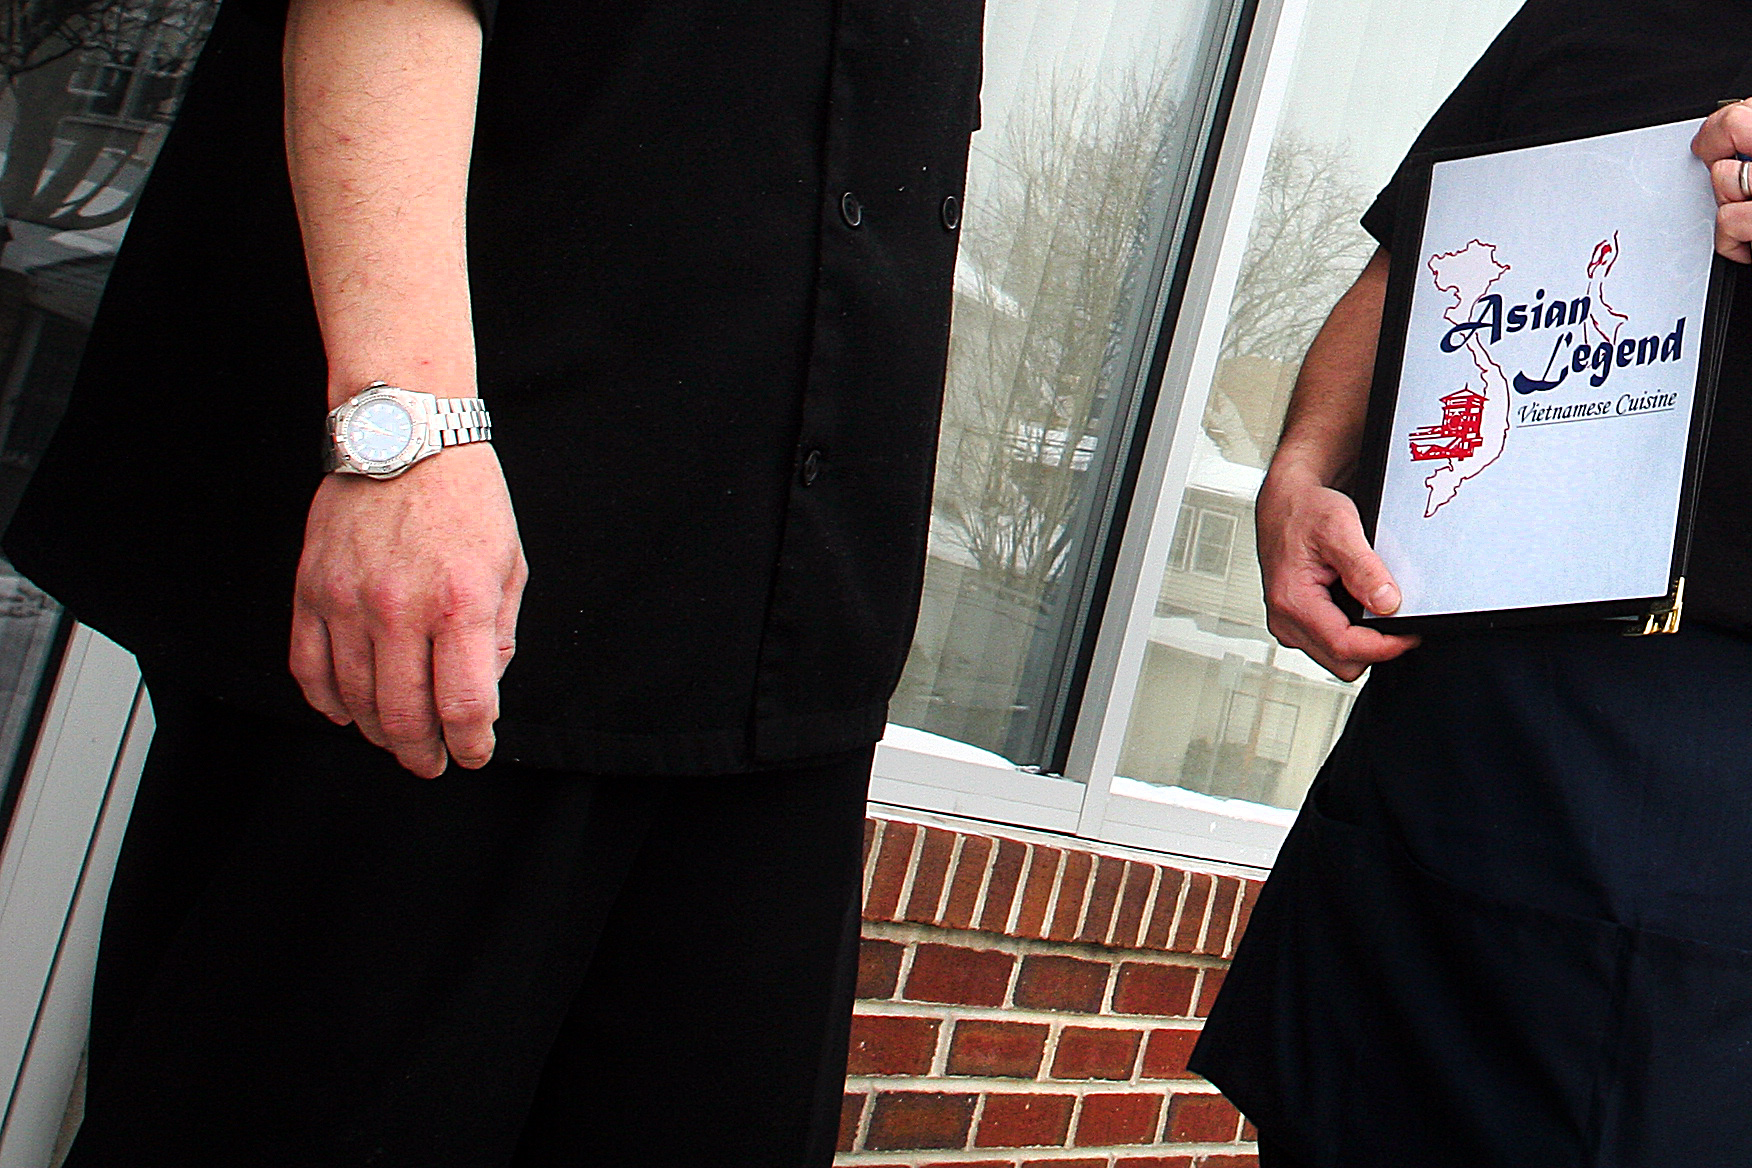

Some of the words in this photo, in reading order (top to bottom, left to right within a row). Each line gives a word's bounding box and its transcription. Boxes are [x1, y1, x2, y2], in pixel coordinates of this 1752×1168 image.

[1440, 288, 1591, 353] Asian
[1512, 317, 1688, 395] Legend
[1517, 399, 1613, 424] Vietnamese
[1615, 389, 1678, 416] Cuisine
